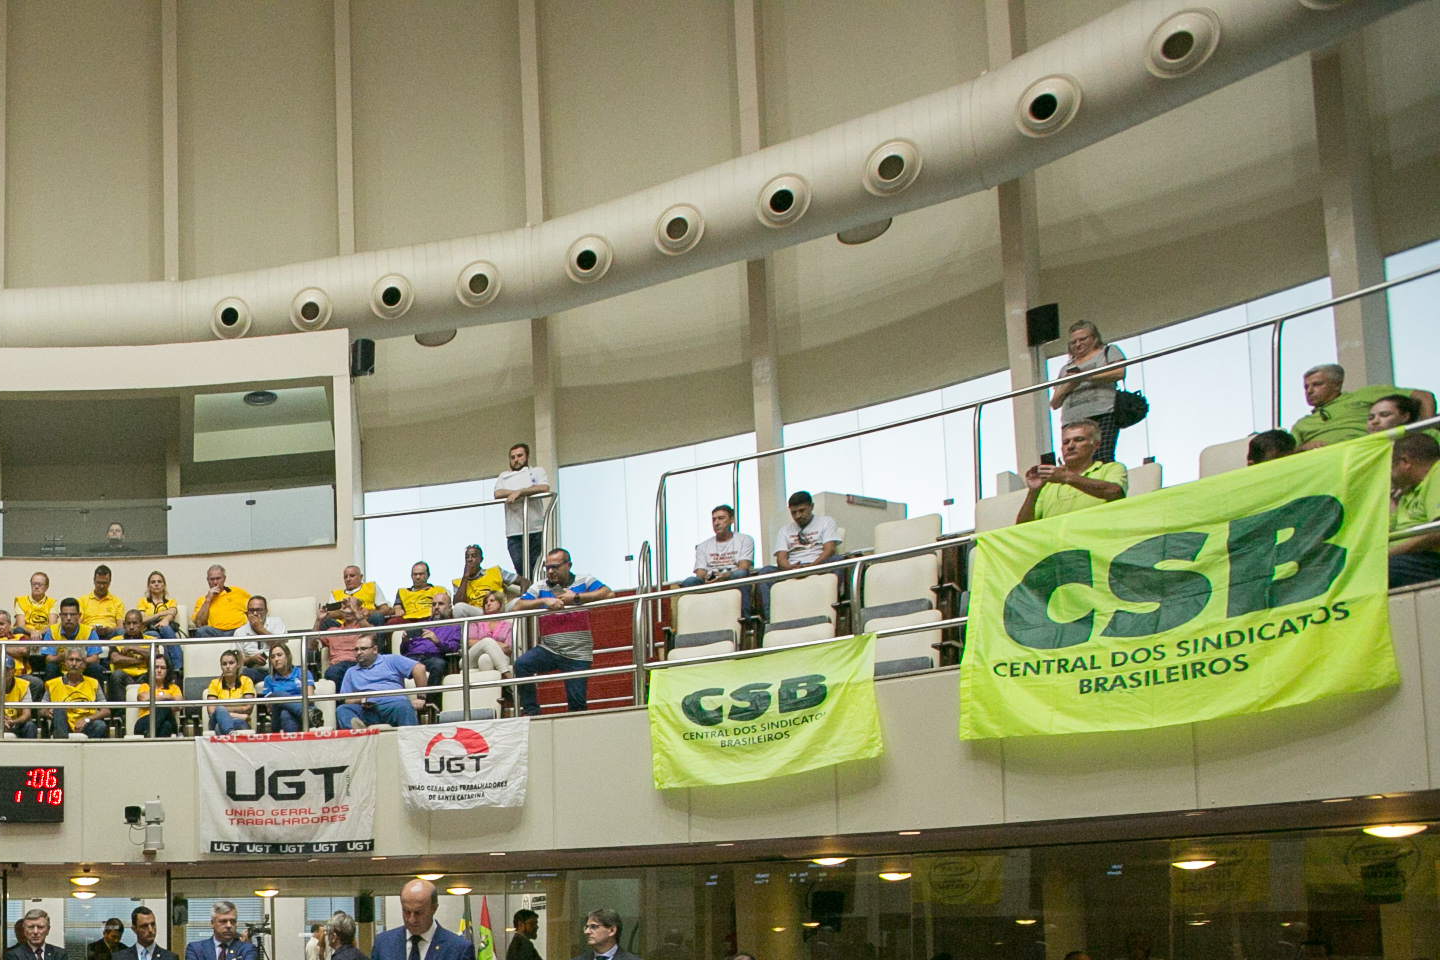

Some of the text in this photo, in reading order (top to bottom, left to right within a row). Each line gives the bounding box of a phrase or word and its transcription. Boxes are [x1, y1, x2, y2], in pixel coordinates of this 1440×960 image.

[1003, 494, 1347, 650] CSB
[993, 601, 1350, 678] CENTRAL DOS SINDICATOS
[1078, 653, 1249, 696] BRASILEIROS
[681, 674, 828, 727] CSB
[682, 728, 731, 741] CENTRAL
[733, 724, 757, 736] DOS
[720, 730, 791, 748] BRASILEIROS
[424, 754, 488, 774] UGT
[226, 765, 350, 803] UGT
[459, 780, 508, 791] TRABALHADORES
[456, 792, 485, 801] CATARINA
[225, 804, 349, 817] UNIÃO GERAL DOS
[228, 813, 347, 826] TRABALHADORES
[213, 840, 372, 853] UGT UGT UGT UGT UGT
